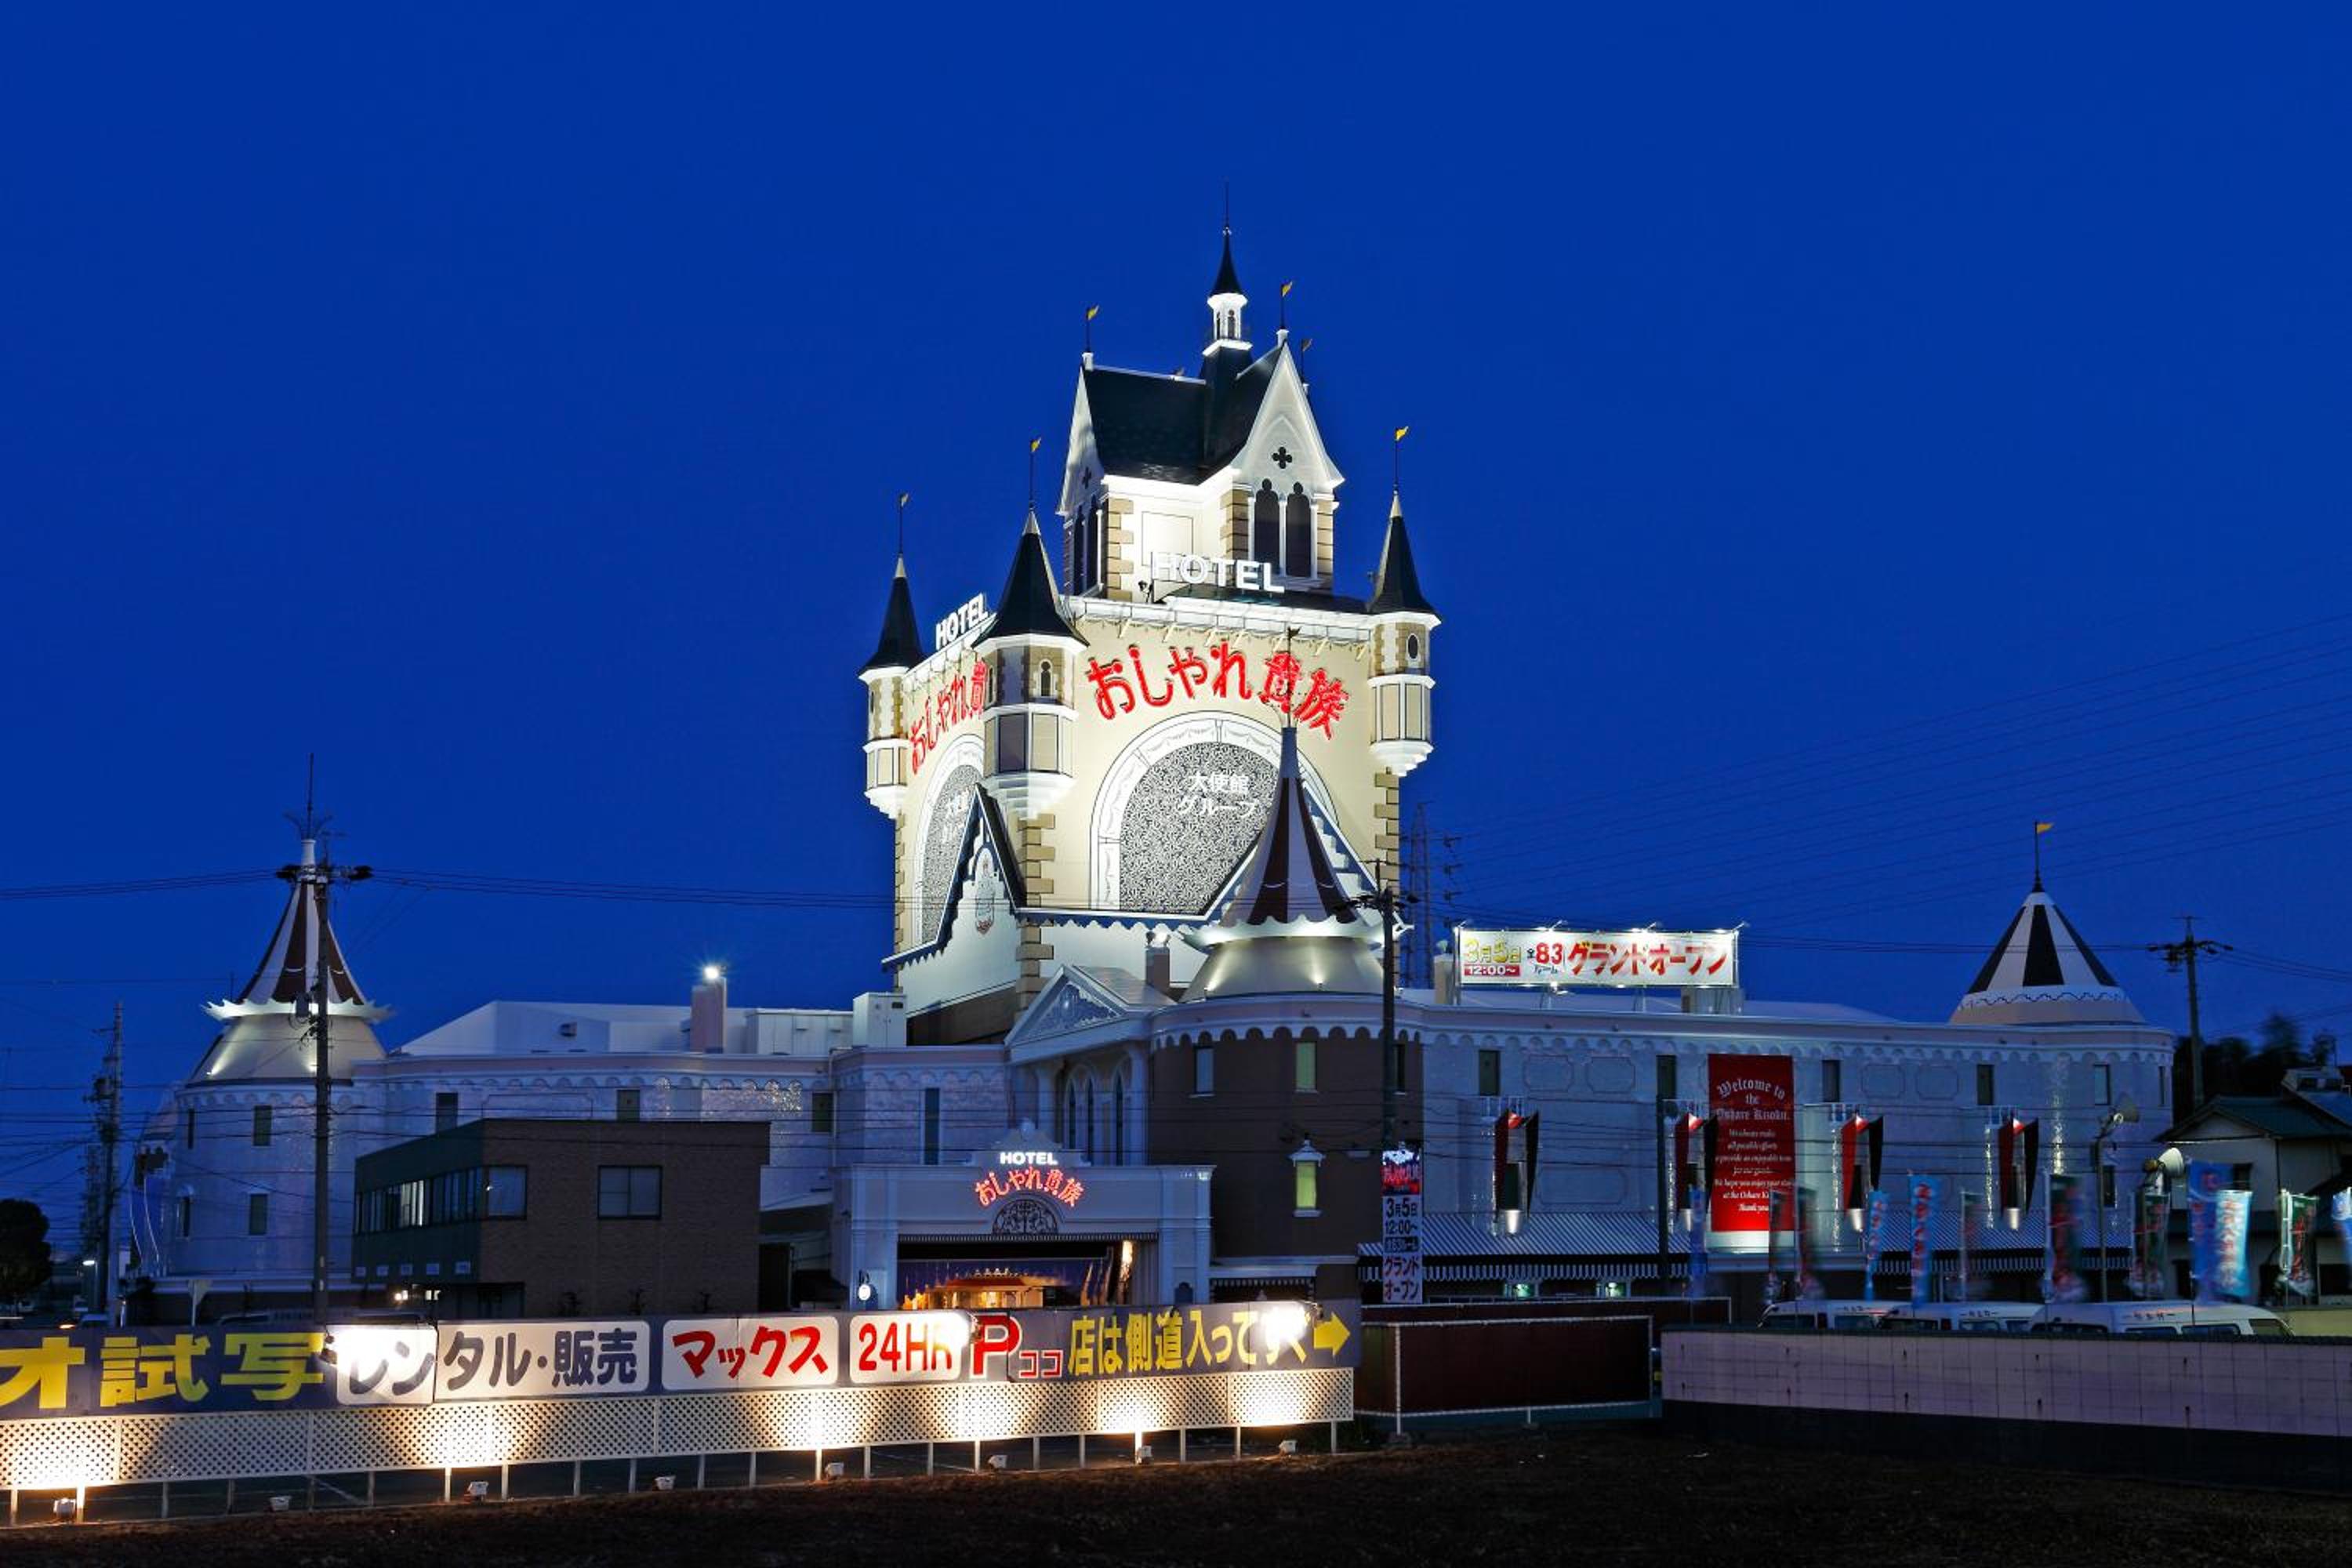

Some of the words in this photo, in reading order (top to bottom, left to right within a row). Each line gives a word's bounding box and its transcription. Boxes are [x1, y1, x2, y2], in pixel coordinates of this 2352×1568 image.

[1152, 552, 1285, 593] HOTEL
[935, 593, 989, 650] HOTEL
[1085, 637, 1350, 740] おしゃれ貴族
[1188, 771, 1250, 794] 大使館
[1567, 942, 1728, 976] グランドオープン
[1716, 1078, 1771, 1099] Welcome
[1773, 1085, 1786, 1100] to
[1746, 1092, 1760, 1104] the
[1000, 1152, 1058, 1165] HOTEL
[975, 1165, 1084, 1207] おしゃれ貴族
[1386, 1197, 1418, 1218] 3月5日
[1384, 1256, 1420, 1277] グランド
[1385, 1279, 1419, 1301] オープン
[672, 1325, 829, 1379] マックス
[972, 1313, 1022, 1378] P
[1018, 1349, 1064, 1379] ココ
